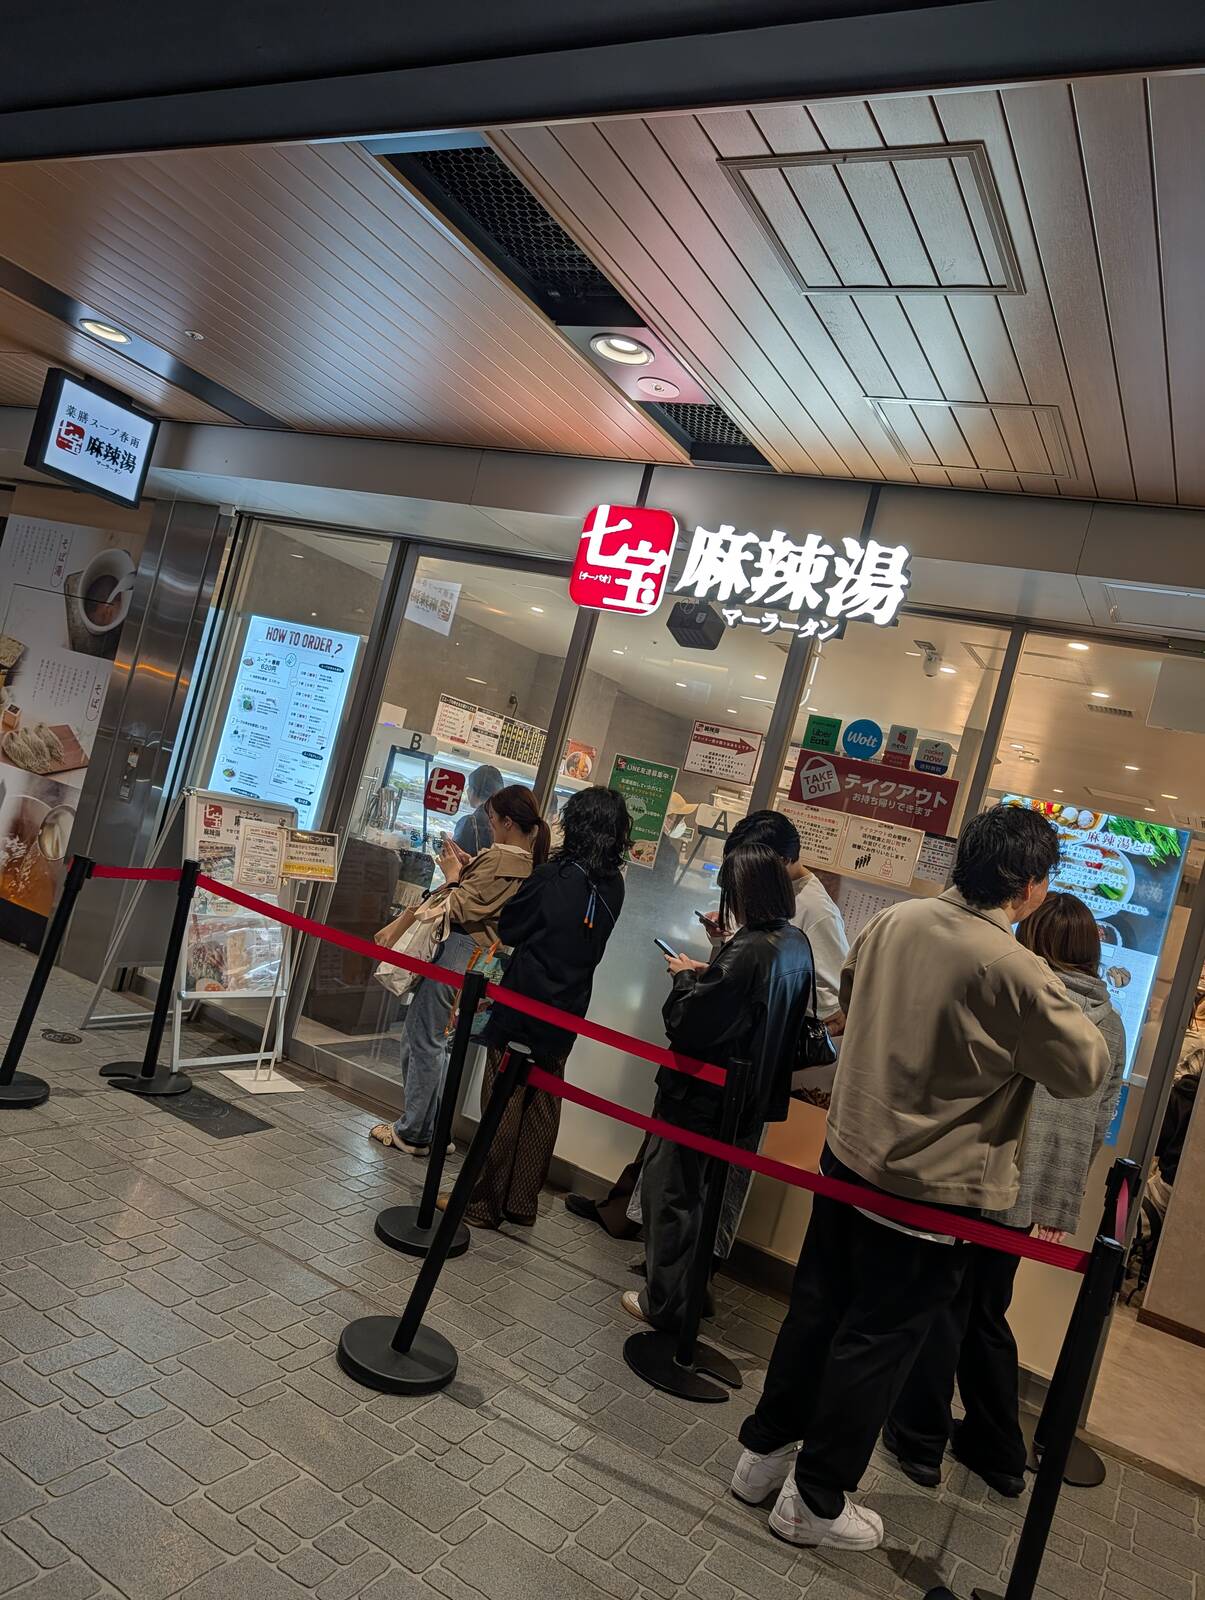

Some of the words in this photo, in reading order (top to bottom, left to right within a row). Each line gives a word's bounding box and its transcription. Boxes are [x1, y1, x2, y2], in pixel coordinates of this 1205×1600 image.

[85, 435, 137, 474] 麻辣湯
[674, 525, 910, 626] 麻辣湯
[722, 609, 839, 641] マーラータン
[266, 626, 288, 643] HOW
[288, 631, 301, 647] TO
[301, 633, 334, 653] ORDER
[410, 733, 422, 750] B
[847, 731, 878, 748] Wolt
[803, 770, 834, 786] TAKE
[808, 780, 833, 795] OUT
[844, 773, 948, 808] テイクアウト
[852, 793, 933, 817] お持ち帰りできます
